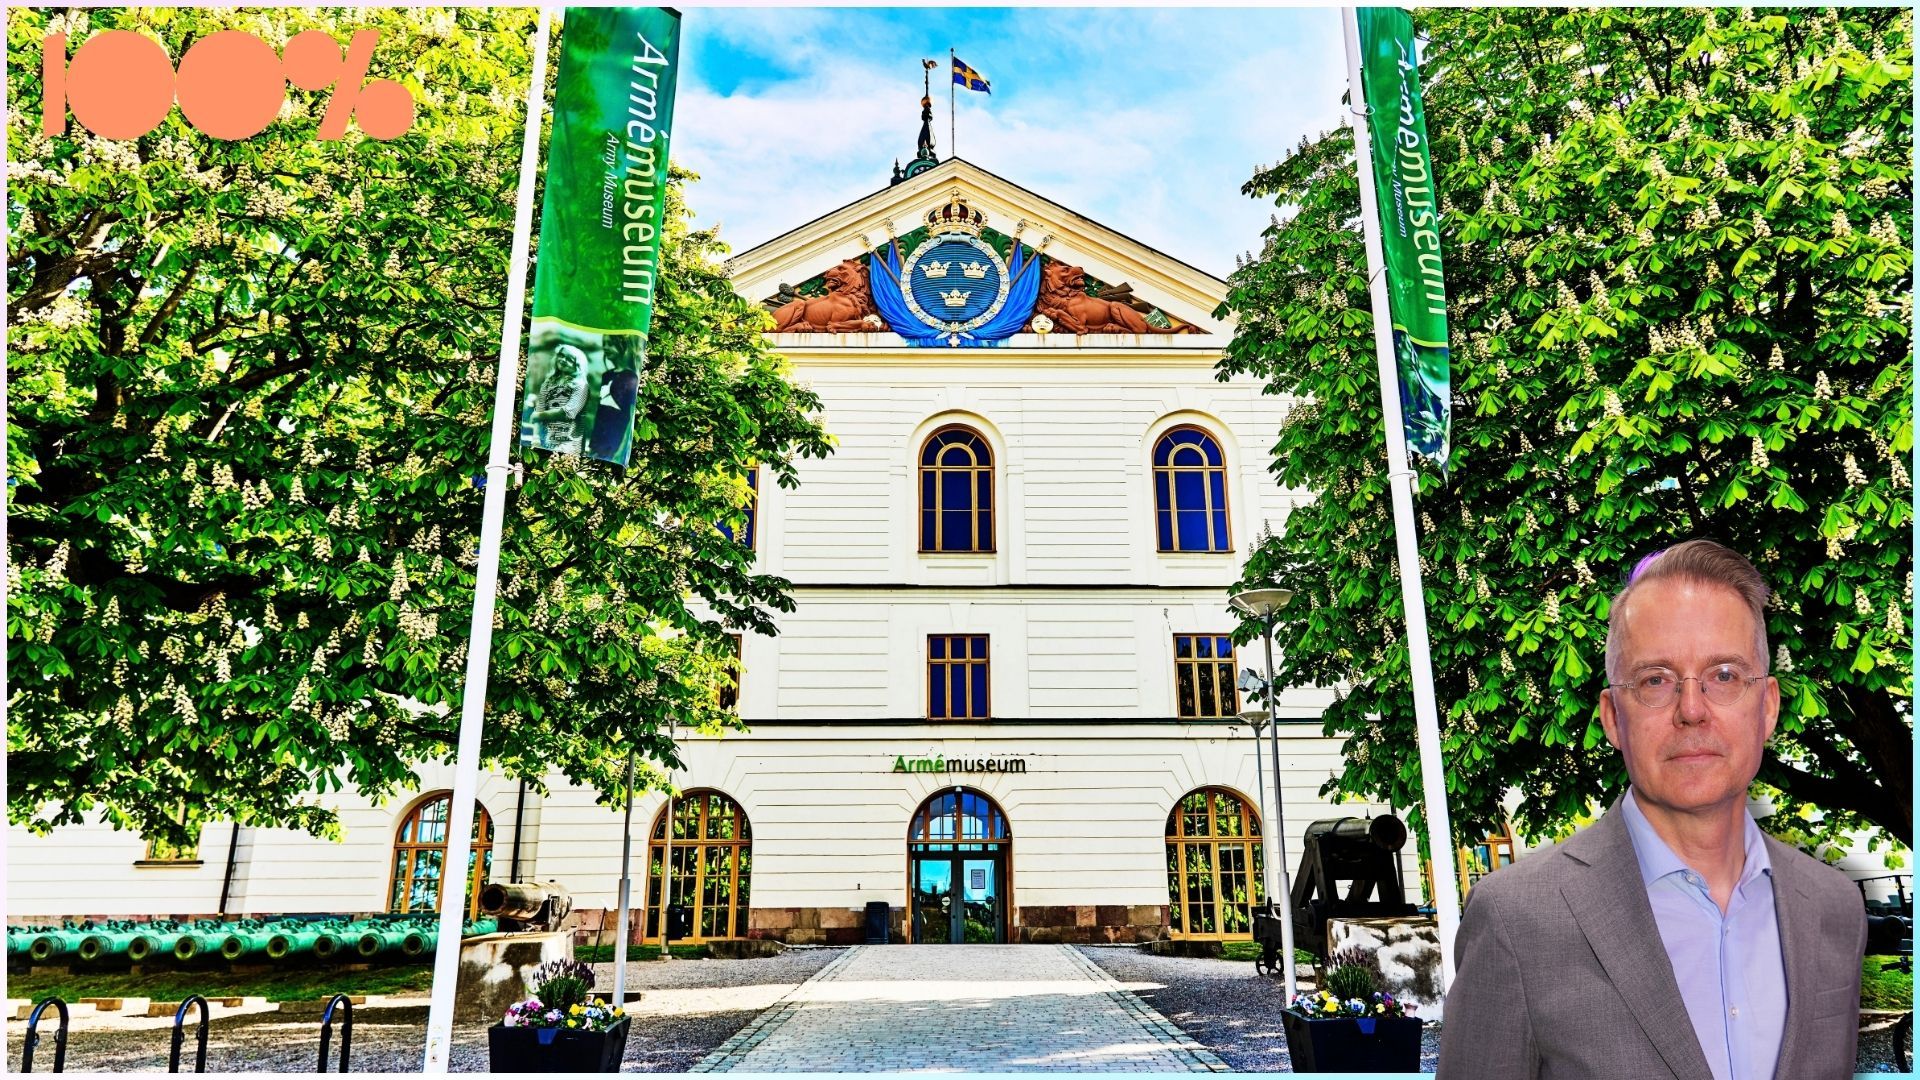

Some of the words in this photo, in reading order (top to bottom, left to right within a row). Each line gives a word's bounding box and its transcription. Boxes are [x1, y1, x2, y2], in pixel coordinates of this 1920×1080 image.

[603, 132, 620, 170] Army
[622, 32, 669, 305] Armémuseum
[602, 171, 618, 229] Museum
[893, 755, 1026, 774] Armémuseum
